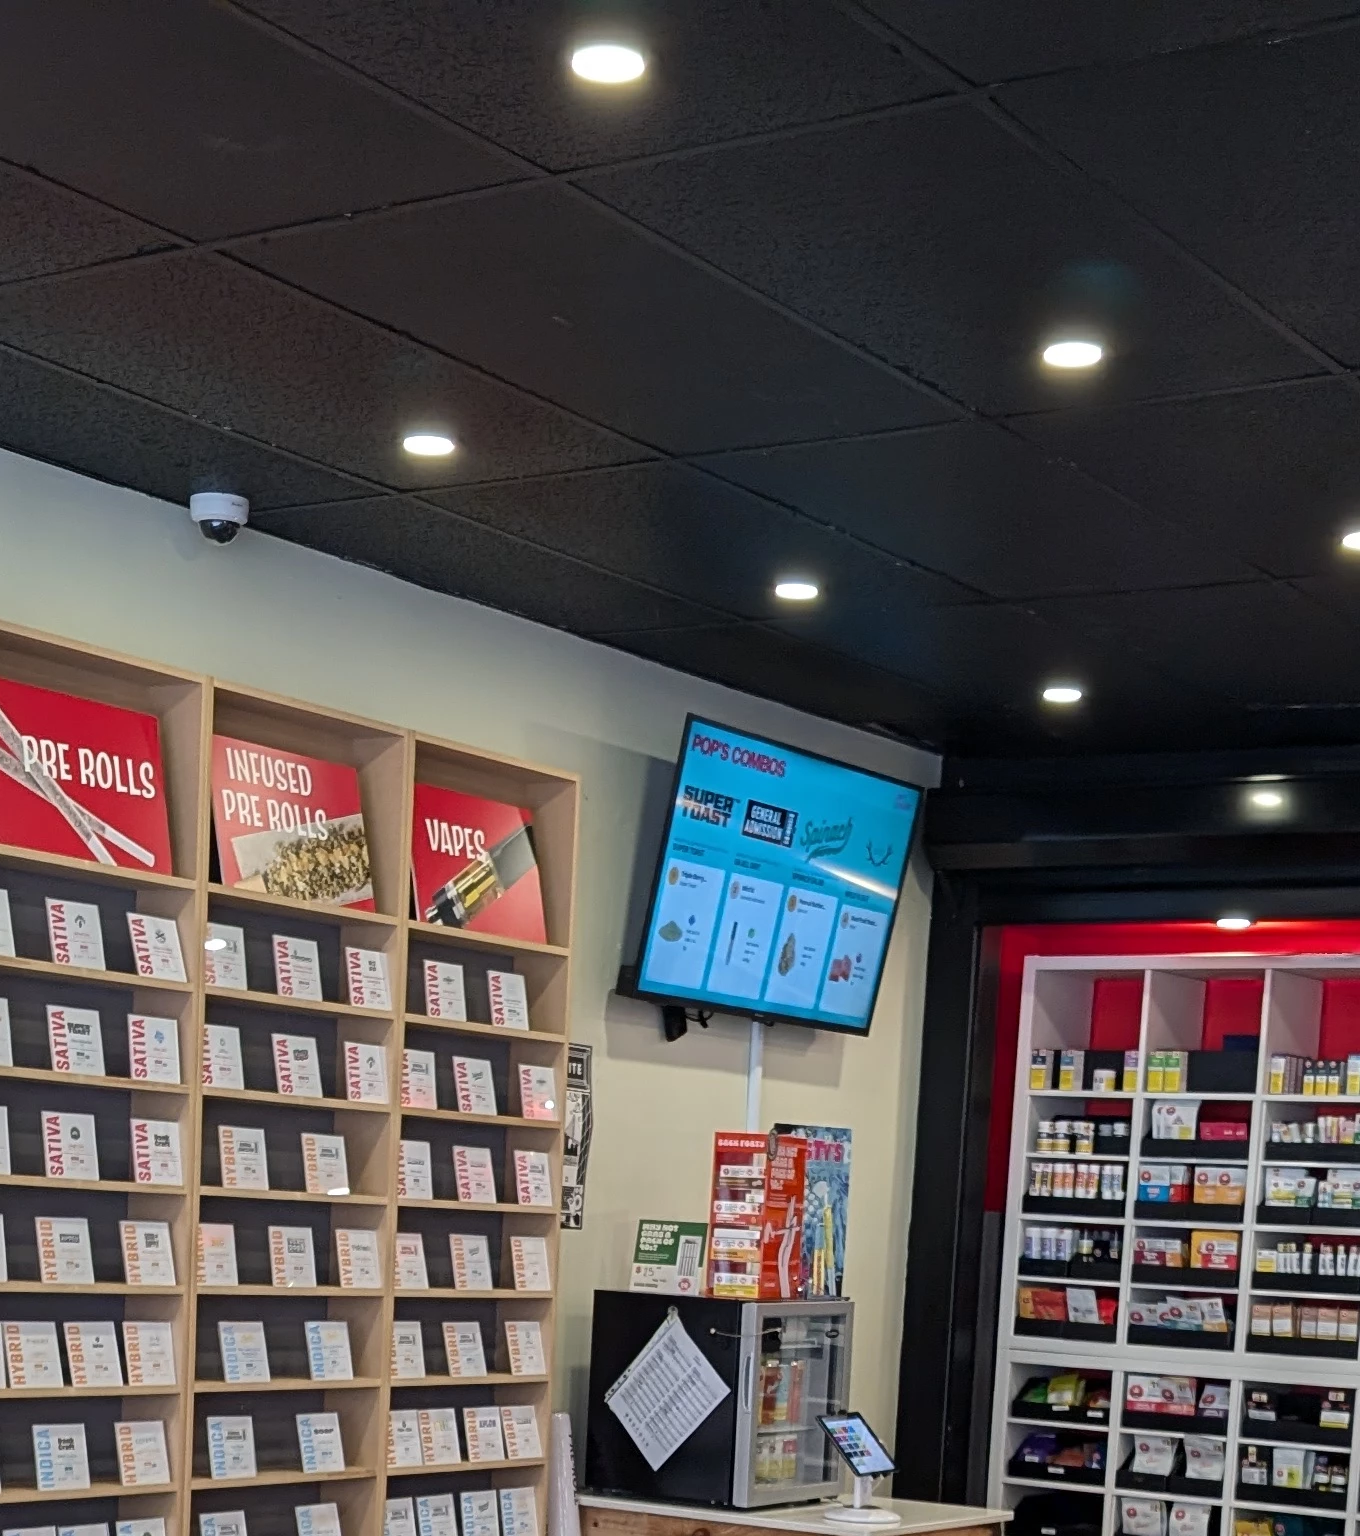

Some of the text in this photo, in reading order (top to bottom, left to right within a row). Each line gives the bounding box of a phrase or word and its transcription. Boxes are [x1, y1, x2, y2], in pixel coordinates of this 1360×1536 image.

[21, 735, 155, 799] PRE ROLLS
[225, 747, 312, 796] INFUSED
[693, 734, 787, 777] POP'S COMBOS
[221, 789, 328, 841] PRE ROLLS
[682, 801, 732, 828] TOAST
[683, 785, 734, 813] SUPER
[424, 819, 486, 860] VAPES
